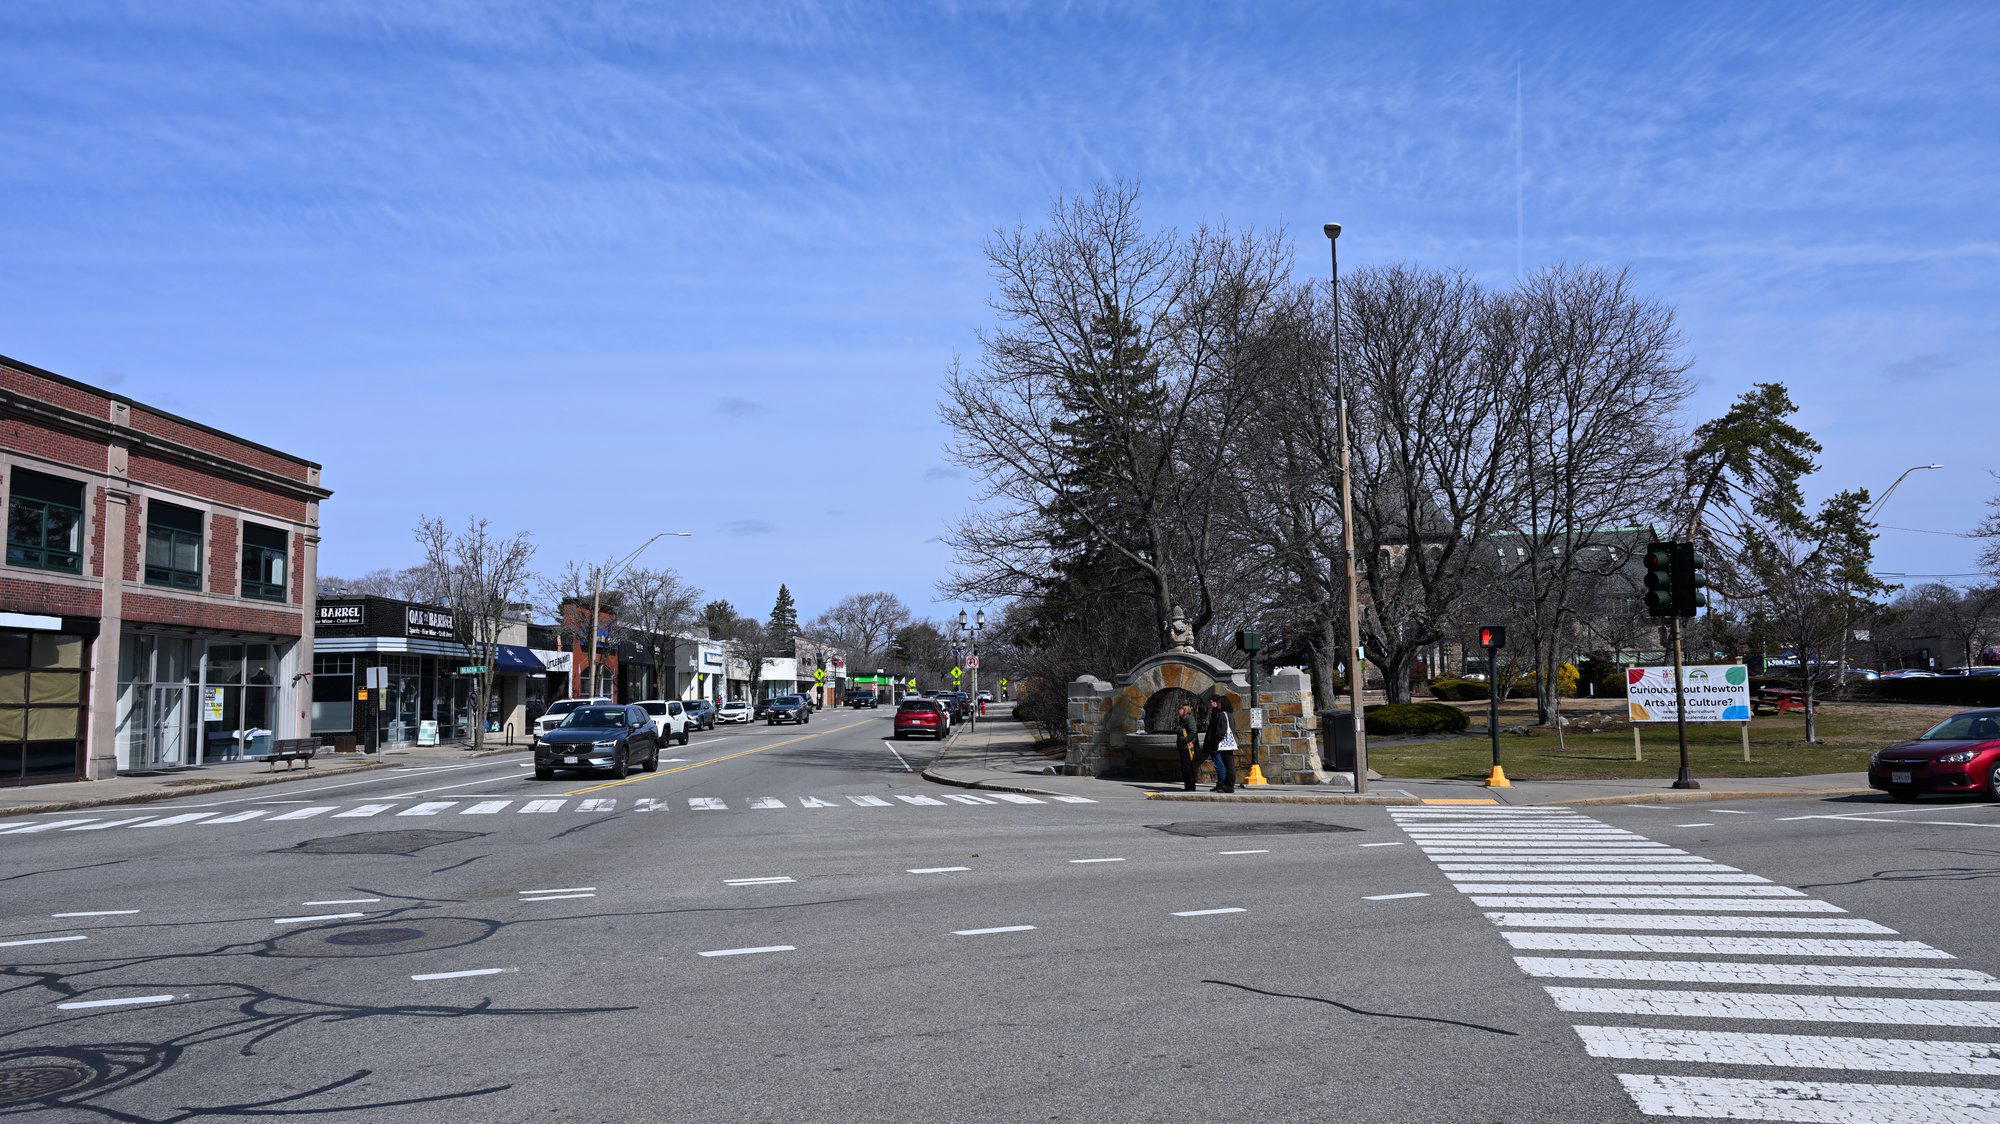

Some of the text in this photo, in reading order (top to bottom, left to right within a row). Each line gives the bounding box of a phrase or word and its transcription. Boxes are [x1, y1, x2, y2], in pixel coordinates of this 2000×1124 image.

[320, 607, 360, 618] BARREL
[409, 610, 424, 625] OAK
[429, 612, 453, 629] BARREL
[1689, 698, 1733, 706] Culture?
